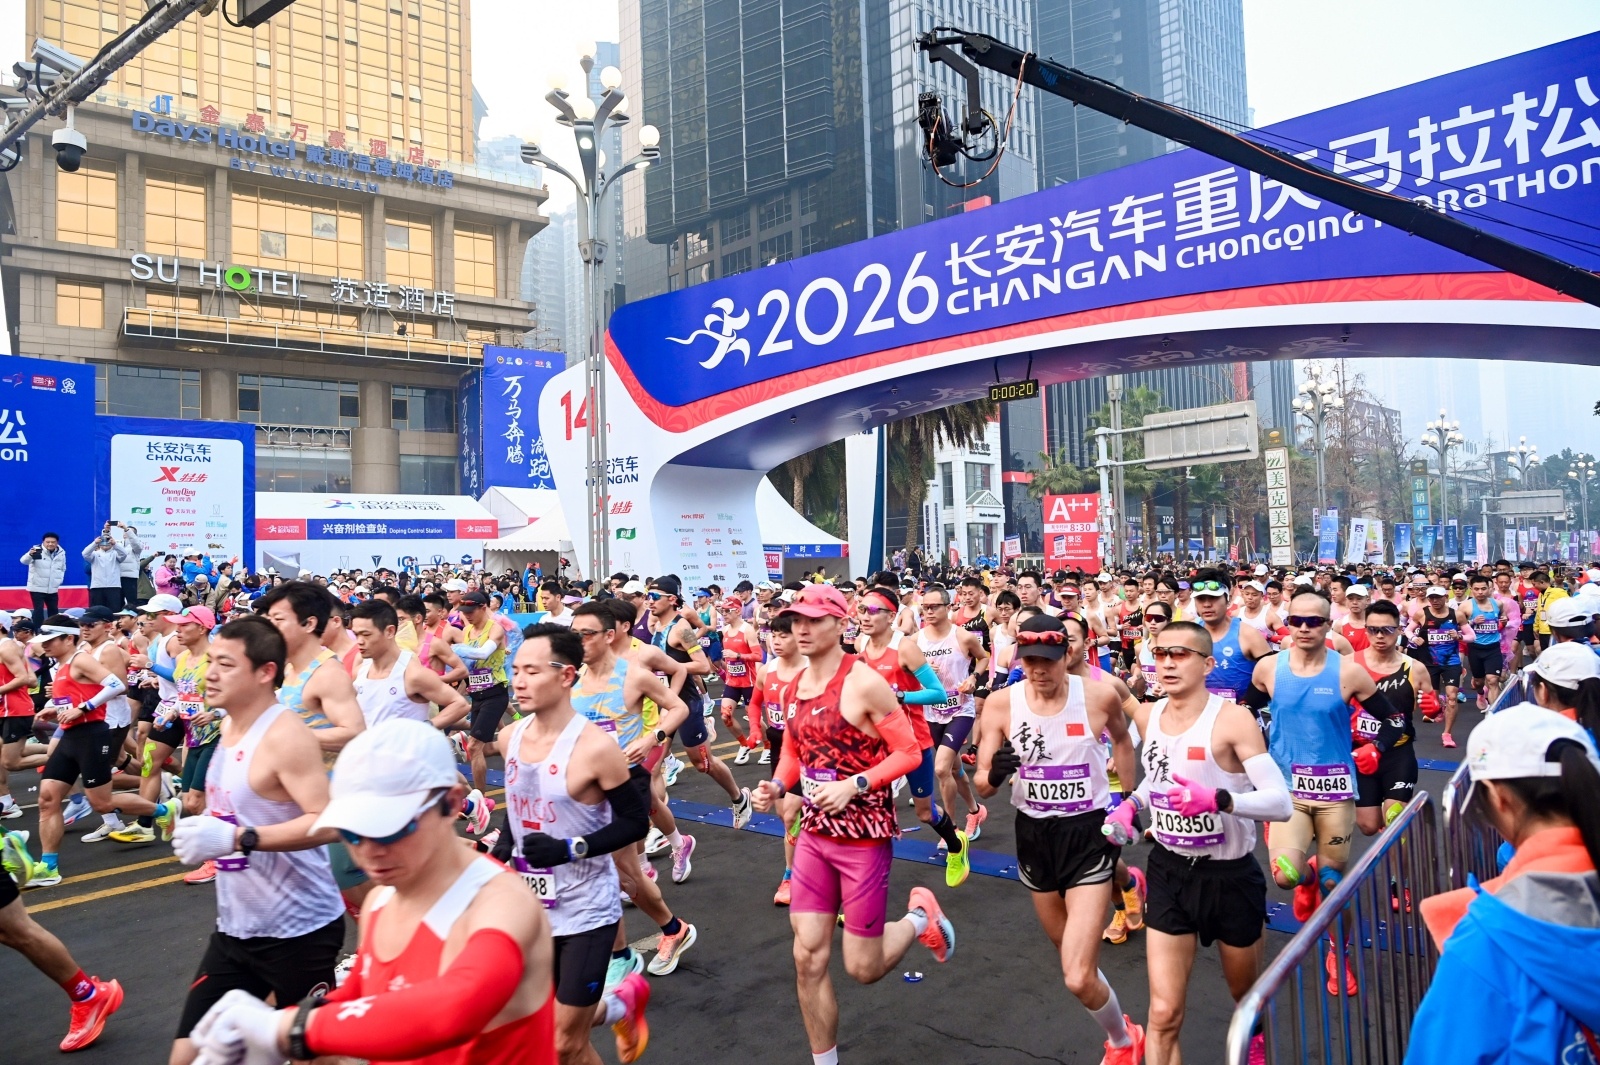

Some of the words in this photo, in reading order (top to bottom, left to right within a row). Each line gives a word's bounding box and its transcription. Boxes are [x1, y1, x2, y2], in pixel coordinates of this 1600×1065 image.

[132, 110, 212, 143] Days
[217, 127, 296, 160] Hotel
[200, 104, 424, 166] 金泰万豪酒店
[229, 157, 257, 172] BY
[270, 164, 380, 194] WYNDHAM
[306, 144, 454, 190] 戴斯温德姆酒店
[945, 193, 1167, 286] 长安汽车
[130, 253, 179, 283] SU
[200, 261, 308, 299] HOTEL
[946, 243, 1167, 316] CHANGAN
[330, 277, 455, 315] 苏适酒店
[756, 250, 939, 357] 2026
[991, 382, 1034, 400] 0:00:20
[500, 375, 525, 464] 万马奔腾
[146, 441, 211, 455] 长安汽车
[146, 454, 211, 462] CHANGAN
[1049, 497, 1093, 521] A++
[1271, 470, 1288, 546] 美克美家
[322, 523, 387, 534] 兴奋剂检查站
[389, 527, 406, 535] Doping
[1069, 523, 1091, 532] 8:30
[784, 545, 821, 553] 计时区
